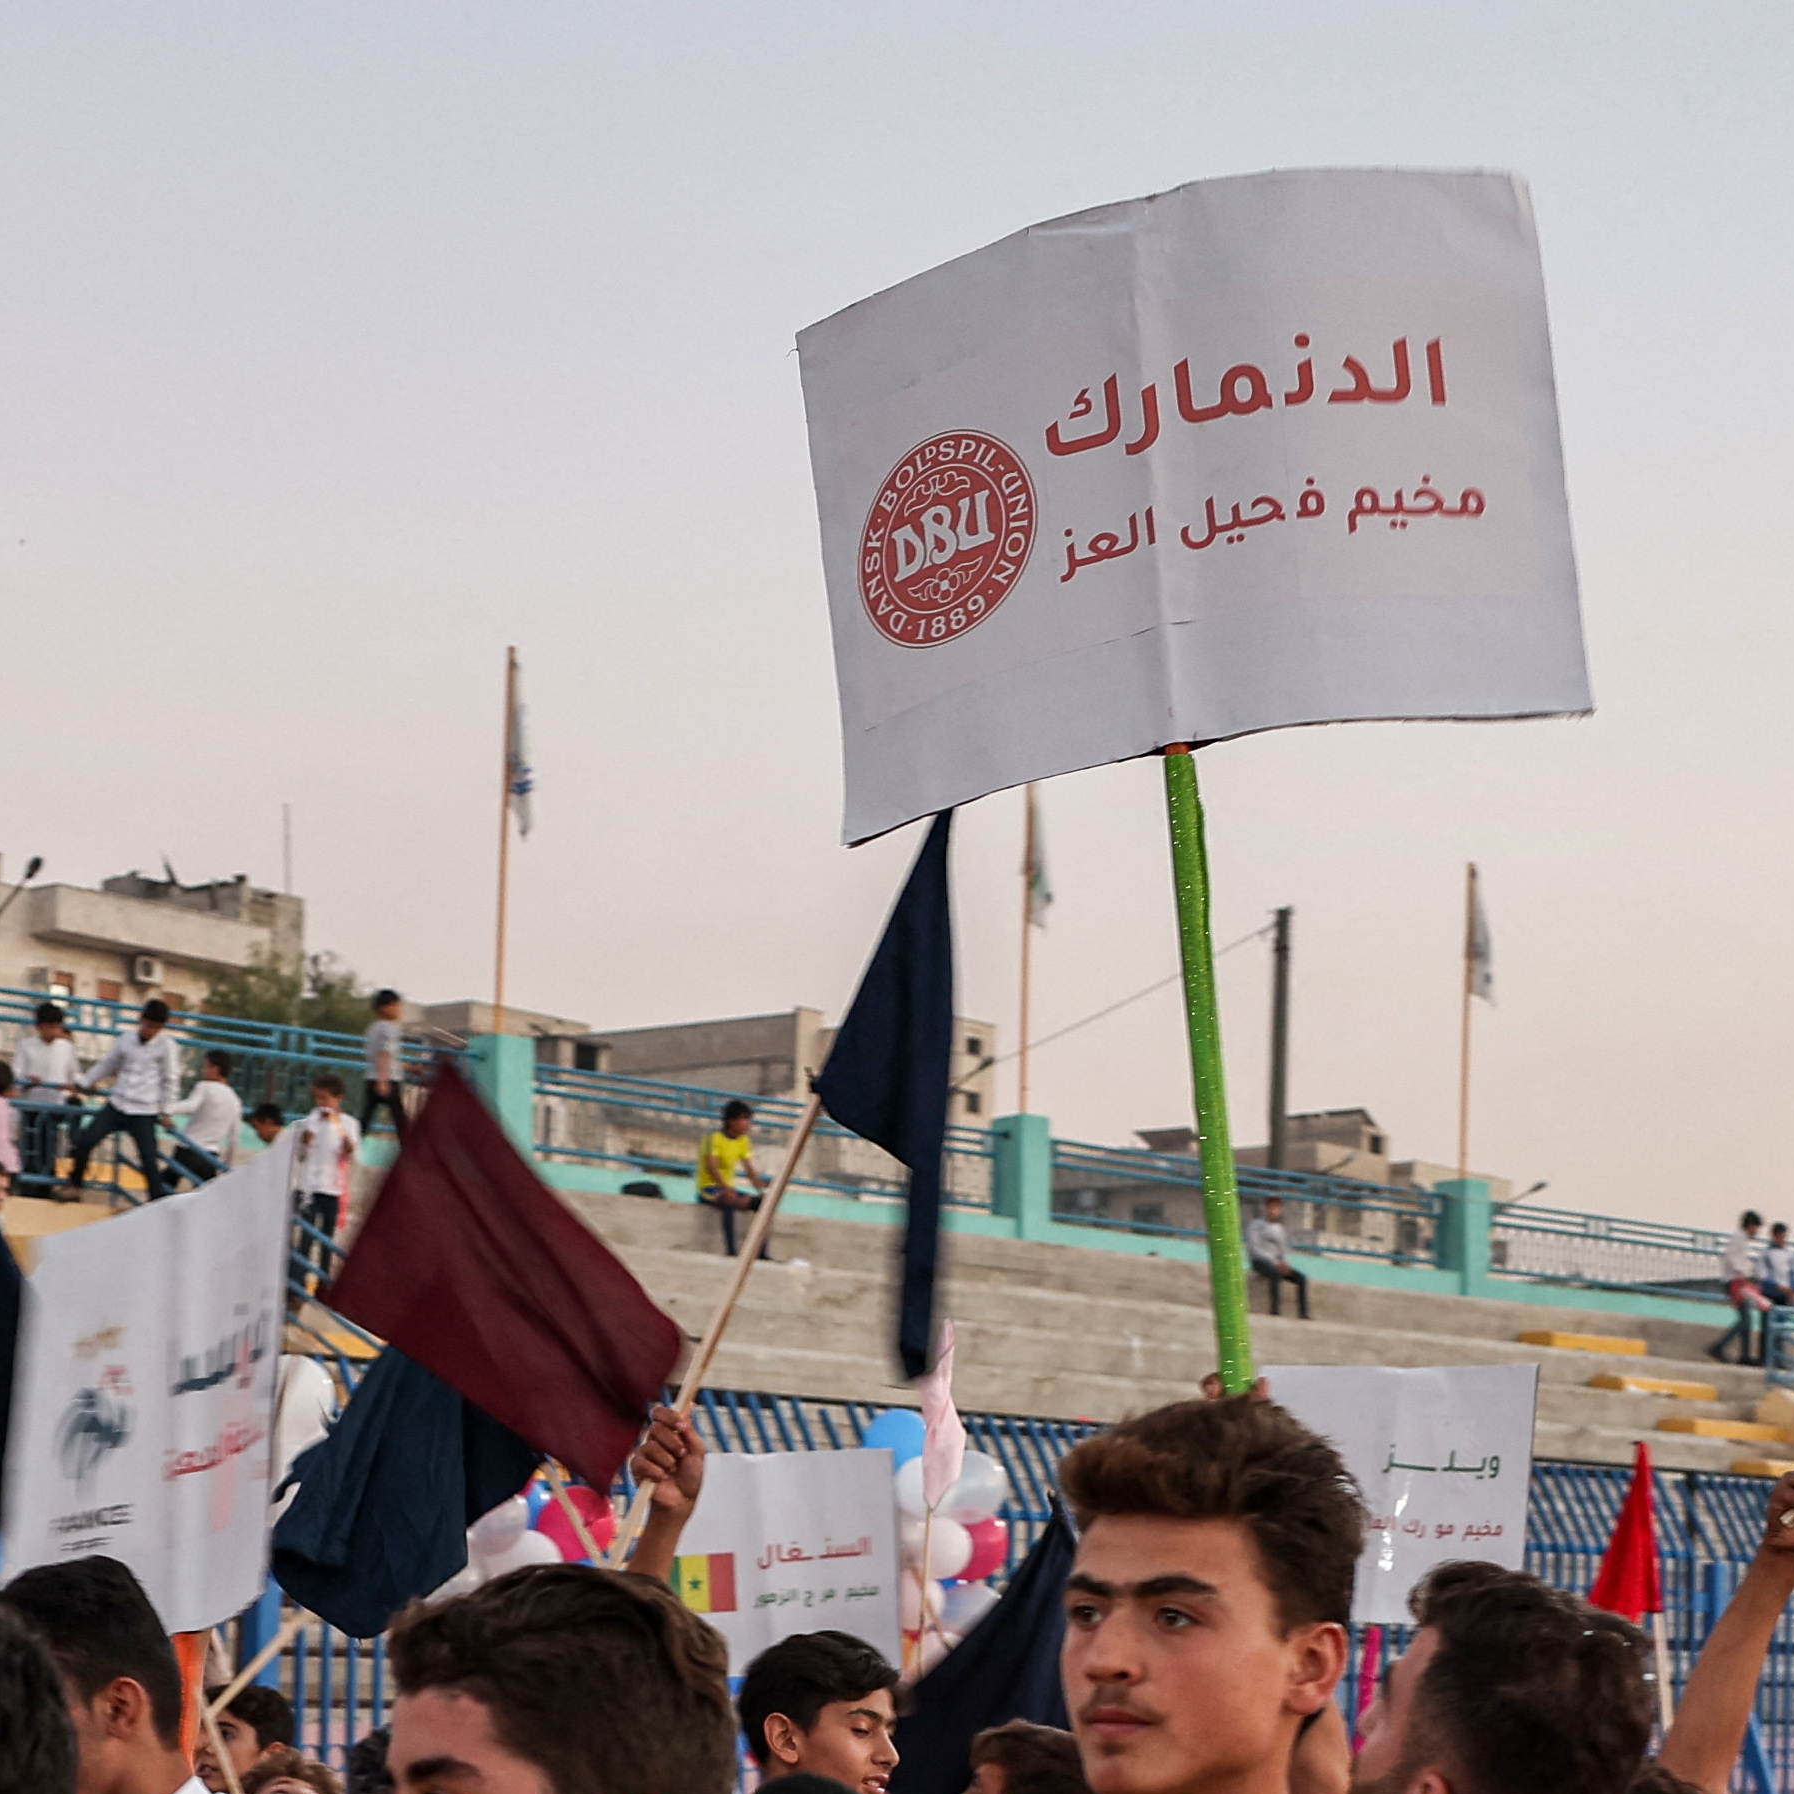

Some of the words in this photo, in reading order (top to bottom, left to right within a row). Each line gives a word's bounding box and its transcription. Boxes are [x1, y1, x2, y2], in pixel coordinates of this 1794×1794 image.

[1044, 332, 1448, 457] الدنمارك
[891, 489, 997, 584] DBU
[1346, 473, 1486, 534] مخيم
[864, 526, 909, 634] DANSK
[1059, 506, 1156, 582] العز
[914, 594, 986, 640] 1889
[1382, 1443, 1500, 1479] ويلز
